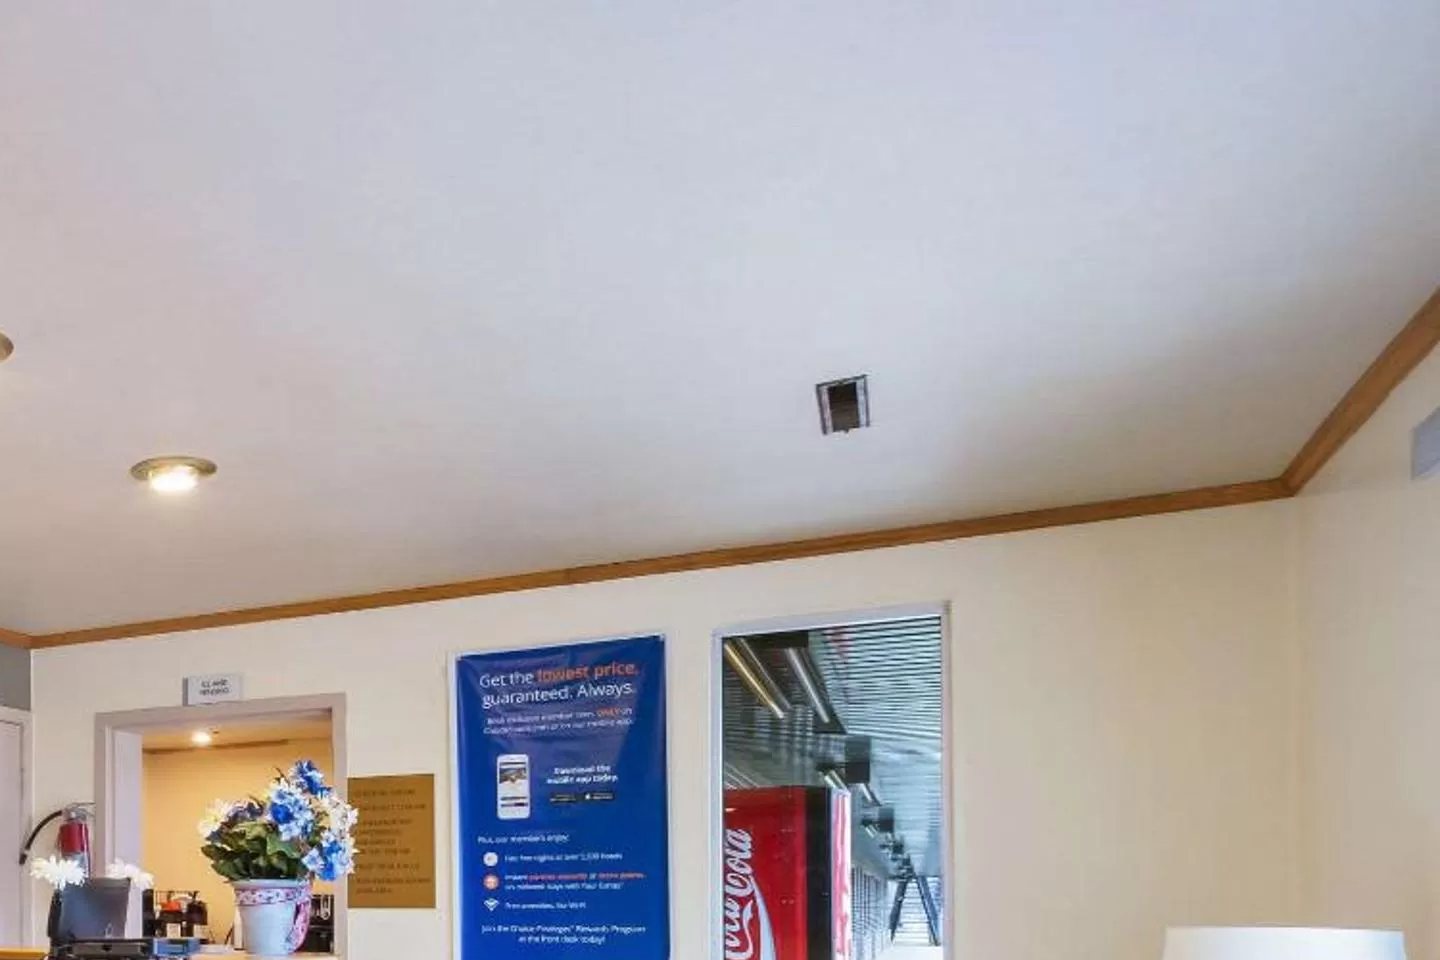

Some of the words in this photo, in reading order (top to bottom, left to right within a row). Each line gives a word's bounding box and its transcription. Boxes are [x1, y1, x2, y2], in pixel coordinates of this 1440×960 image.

[479, 673, 509, 689] Get
[509, 671, 535, 686] the
[538, 663, 590, 684] lowest
[482, 686, 573, 710] guaranteed.
